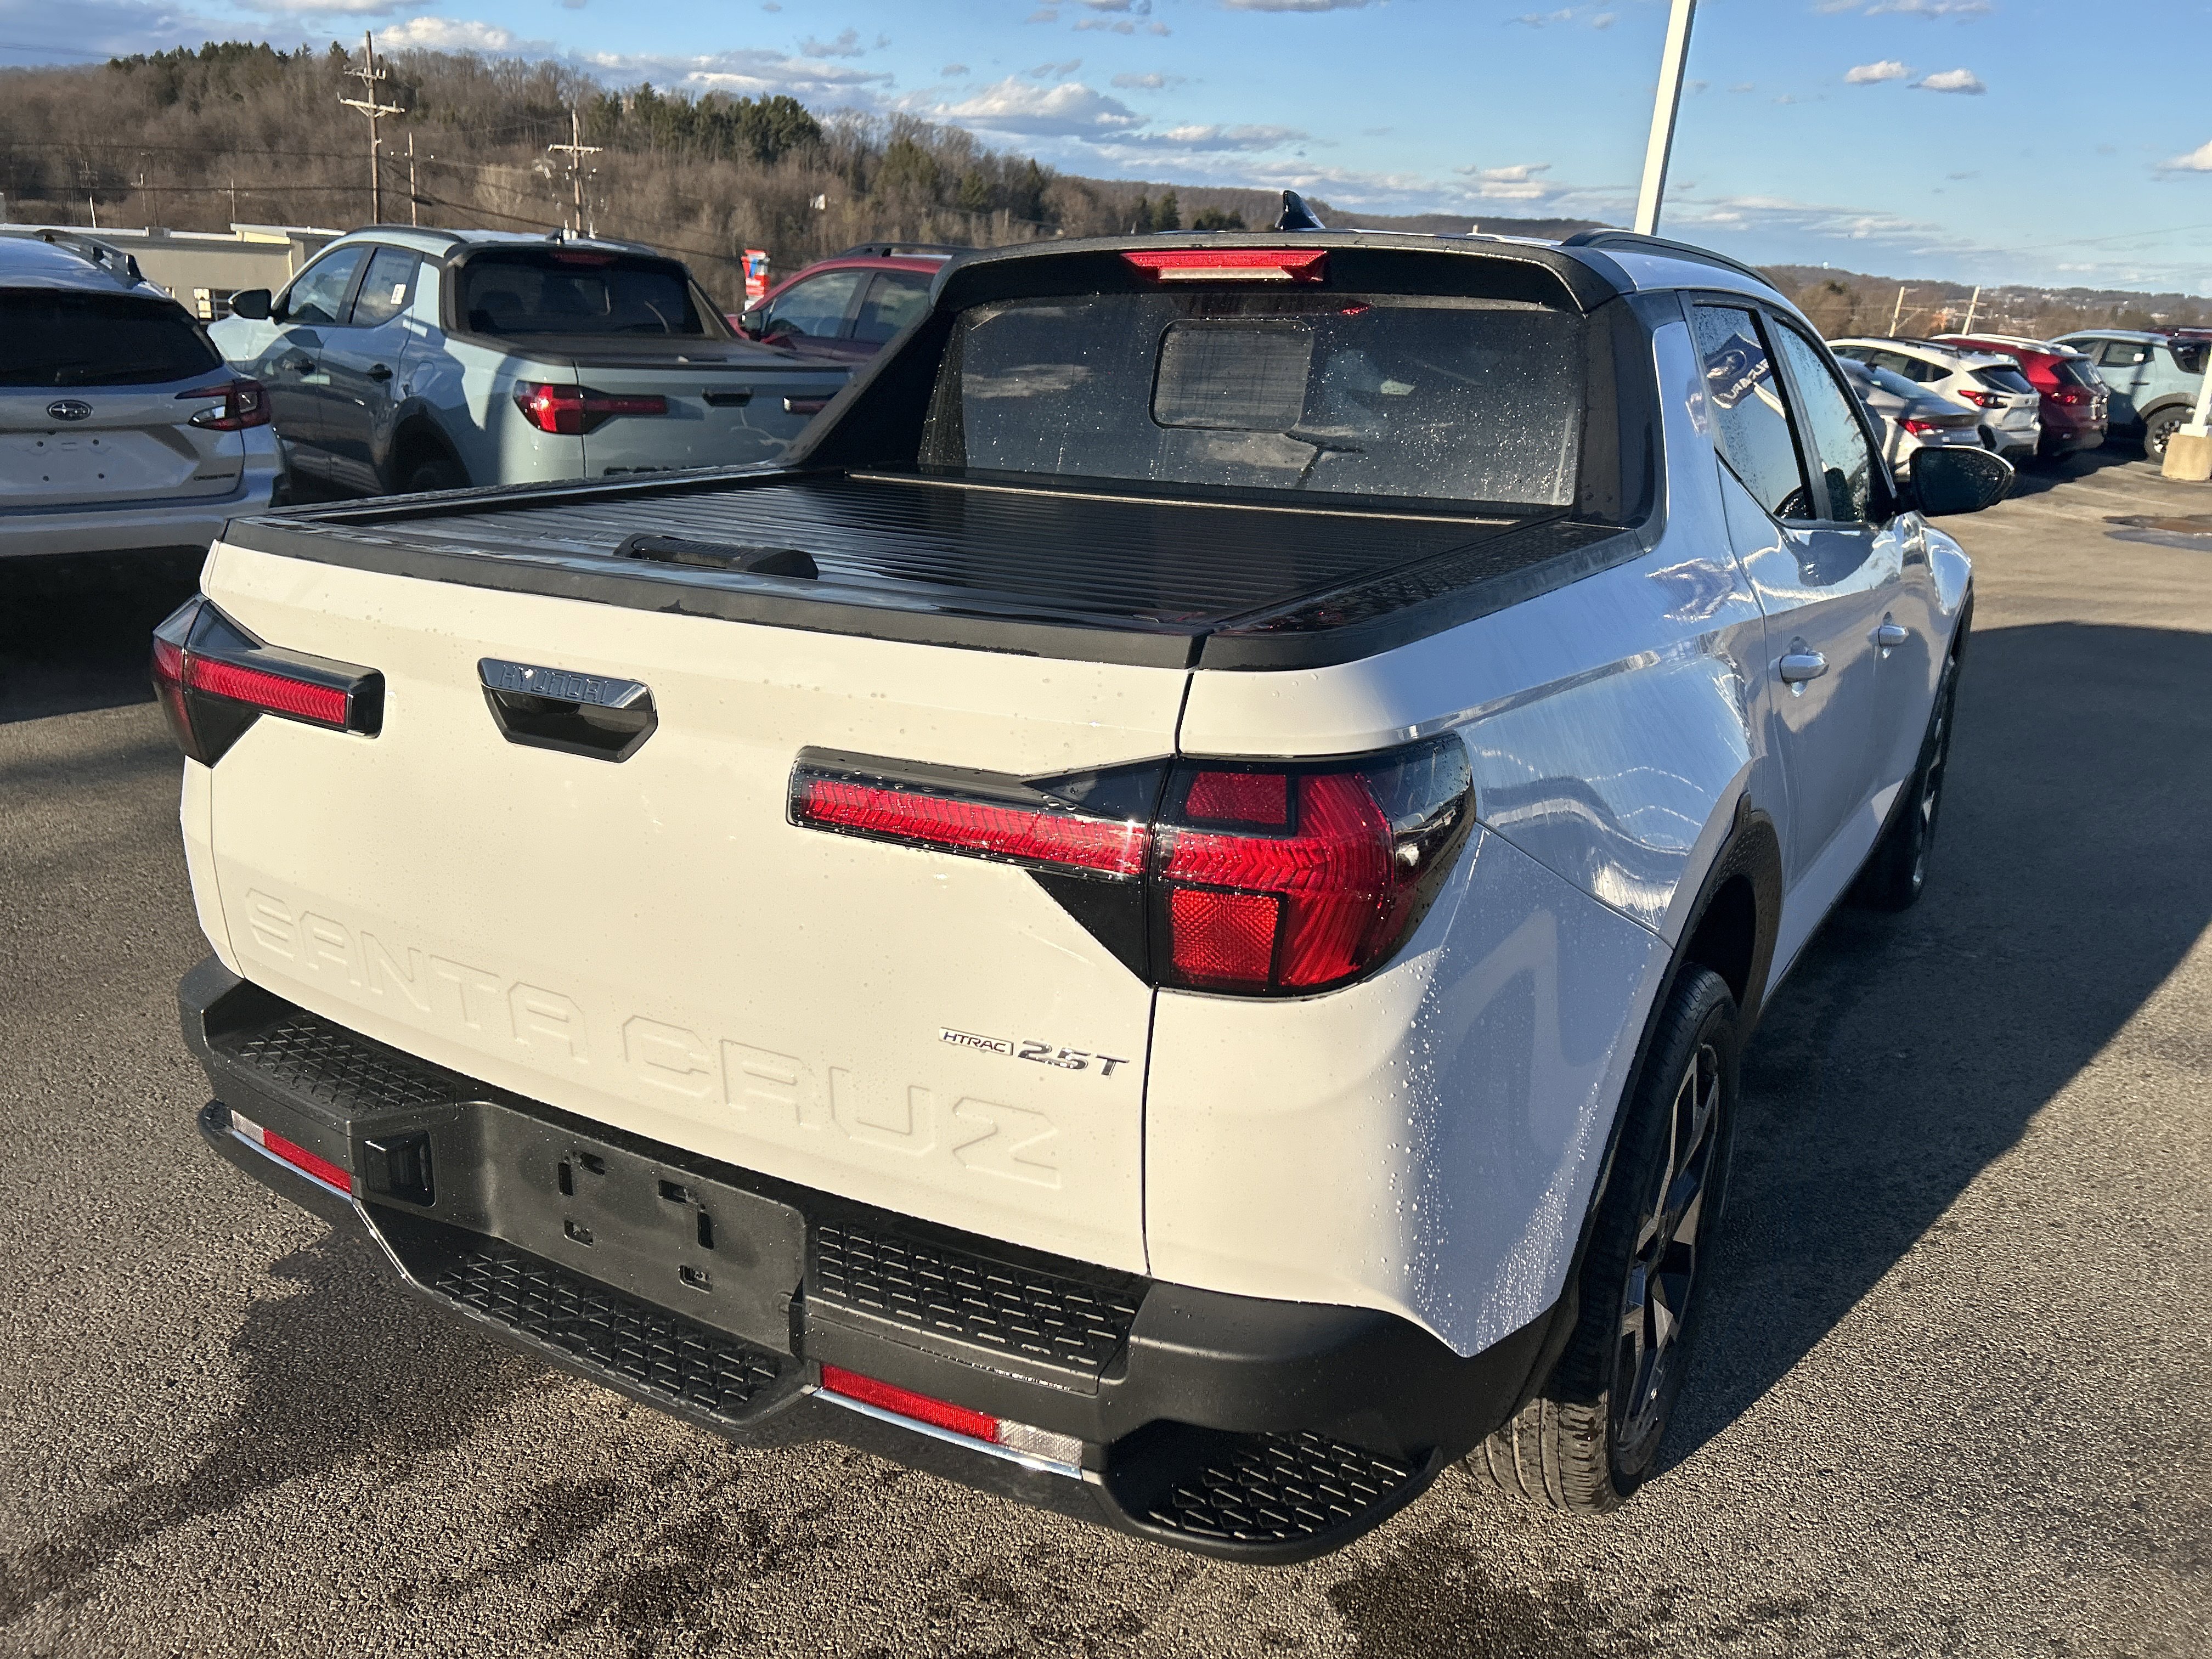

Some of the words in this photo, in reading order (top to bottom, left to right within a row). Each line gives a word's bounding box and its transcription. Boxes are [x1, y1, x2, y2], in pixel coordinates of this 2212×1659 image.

[499, 664, 609, 703] HYUNDAI
[245, 888, 589, 1064] SANTA
[622, 1015, 1061, 1190] CRUZ
[943, 1031, 1006, 1053] HTRAC
